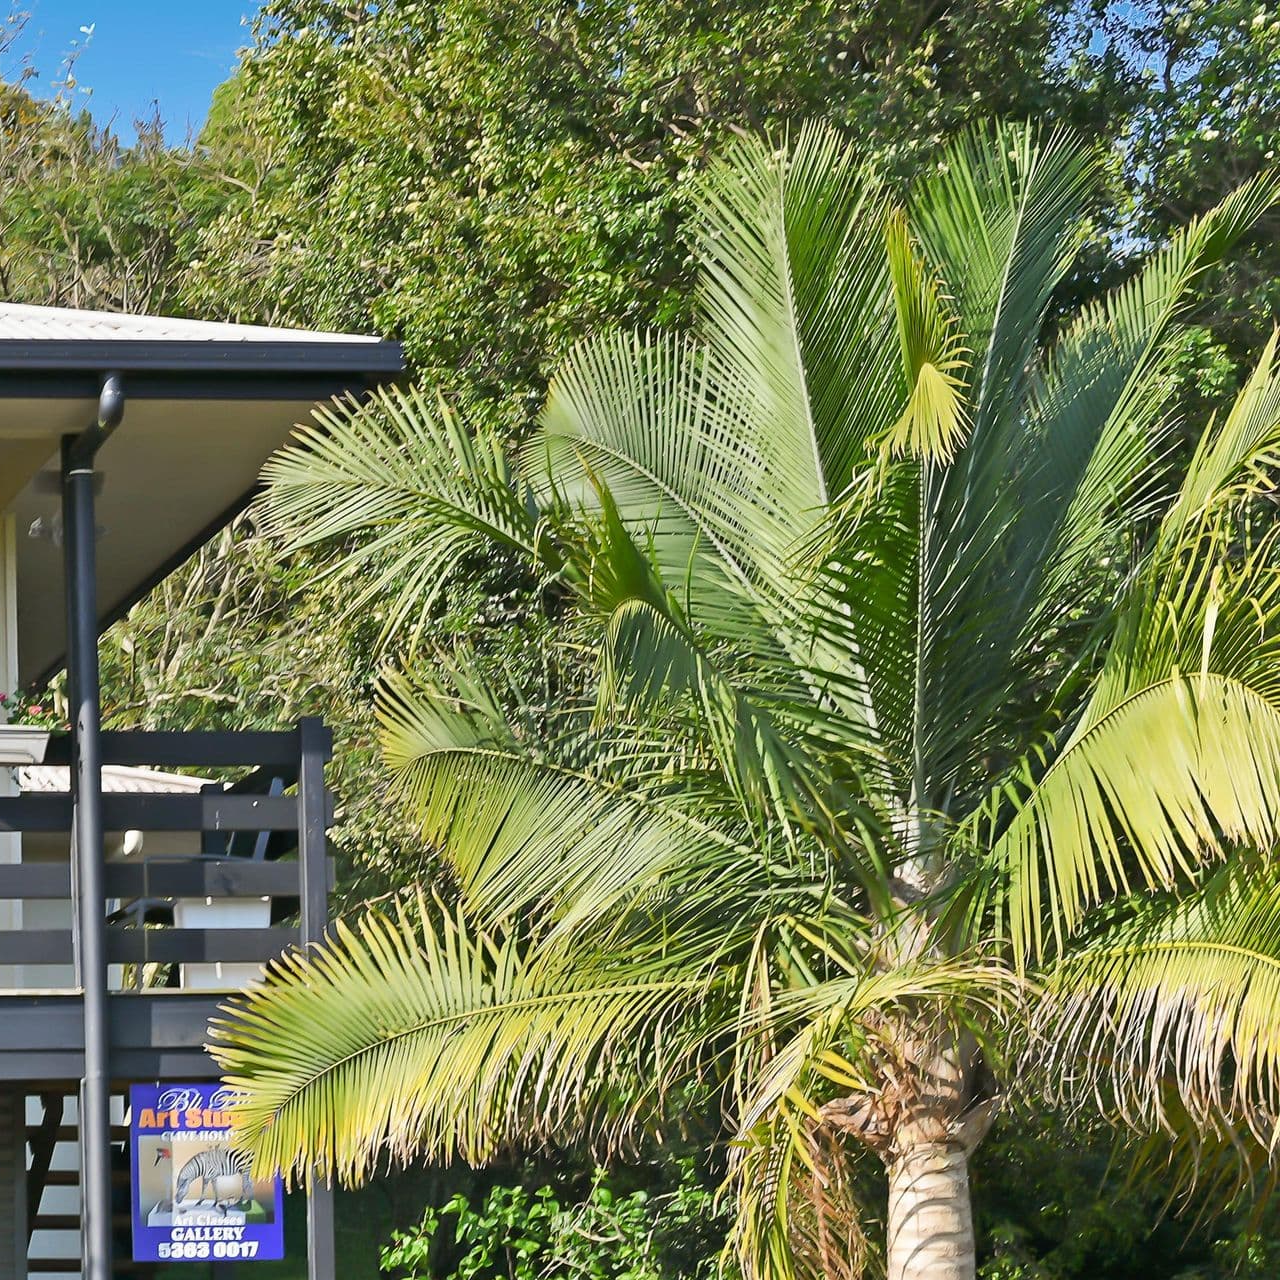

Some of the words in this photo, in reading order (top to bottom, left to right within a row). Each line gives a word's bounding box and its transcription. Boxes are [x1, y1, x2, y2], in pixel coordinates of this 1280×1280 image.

[139, 1108, 180, 1128] Art
[185, 1107, 270, 1129] Stu
[174, 1215, 194, 1226] Art
[196, 1215, 243, 1226] Classes
[171, 1226, 246, 1241] GALLERY
[213, 1241, 259, 1258] 0017
